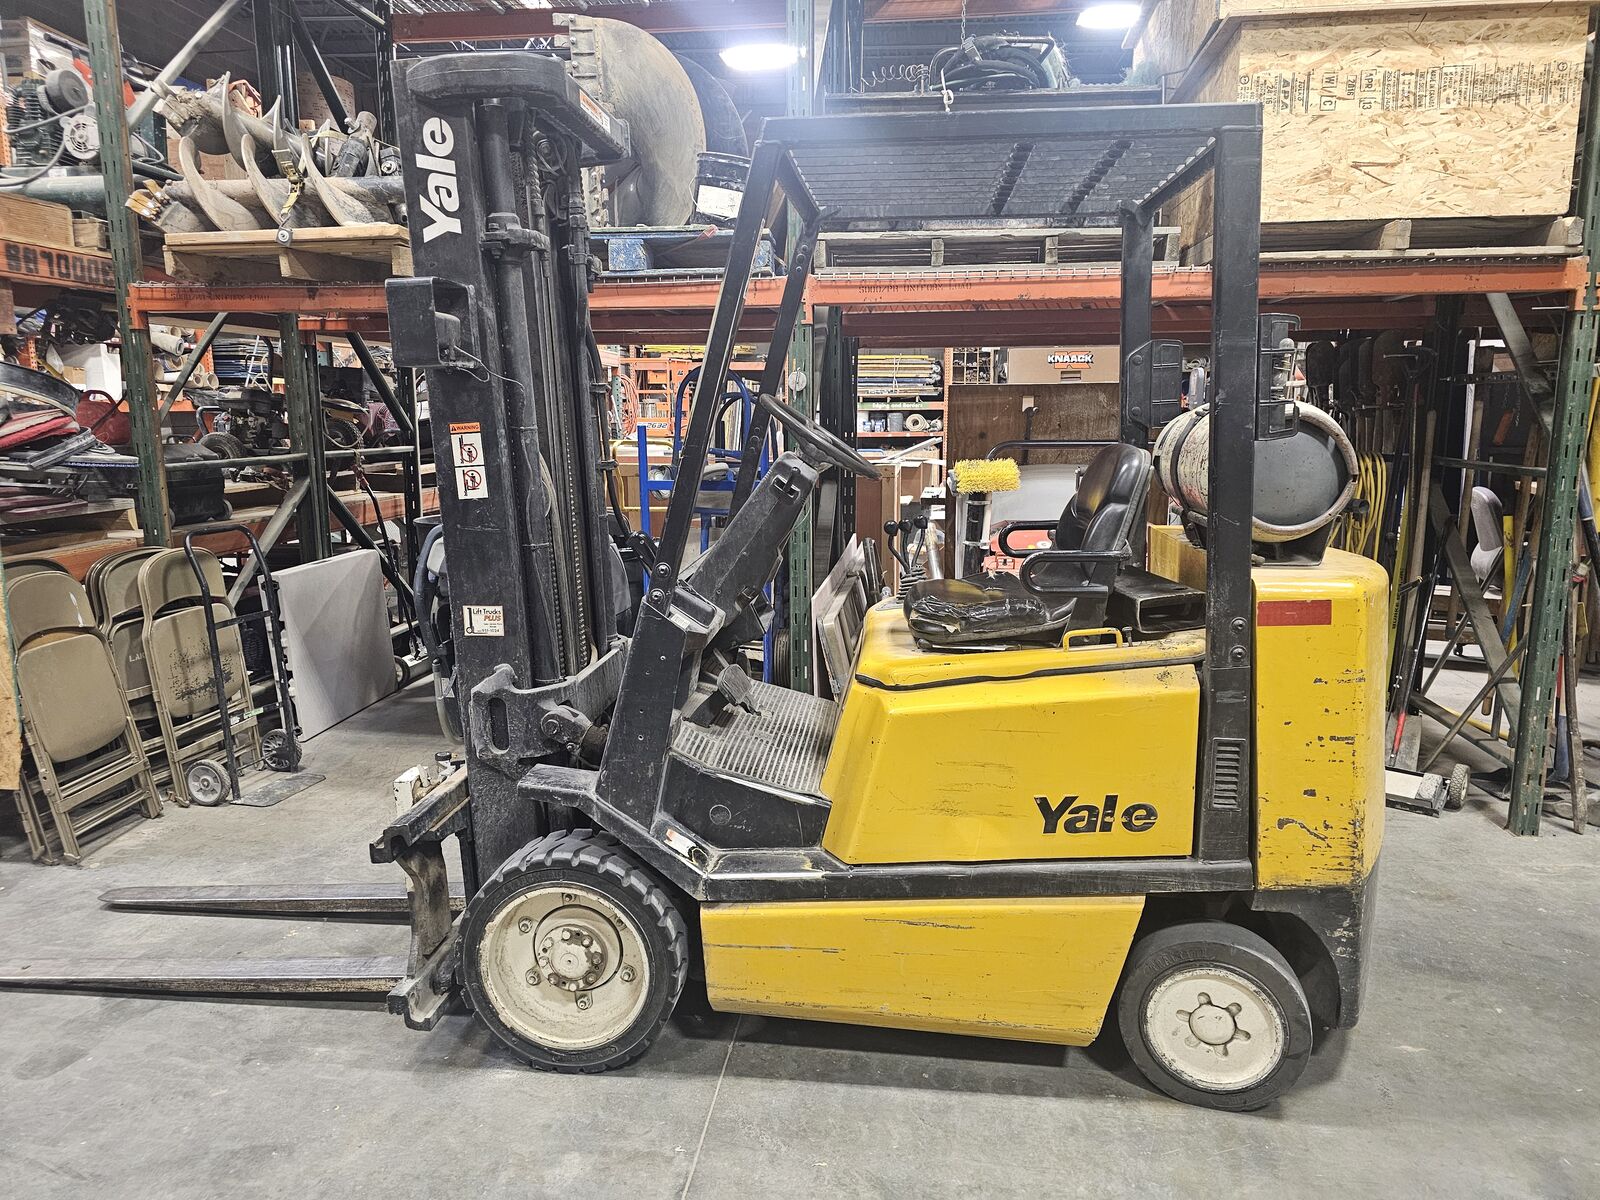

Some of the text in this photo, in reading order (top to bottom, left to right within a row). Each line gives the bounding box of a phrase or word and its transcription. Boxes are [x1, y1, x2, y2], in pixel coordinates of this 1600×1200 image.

[1346, 79, 1356, 96] 2016
[1364, 72, 1374, 89] APR
[1281, 78, 1291, 111] APA
[1362, 101, 1373, 110] 13
[415, 116, 462, 244] Yale
[1047, 354, 1094, 364] KNAACK
[1033, 794, 1158, 836] Yale
